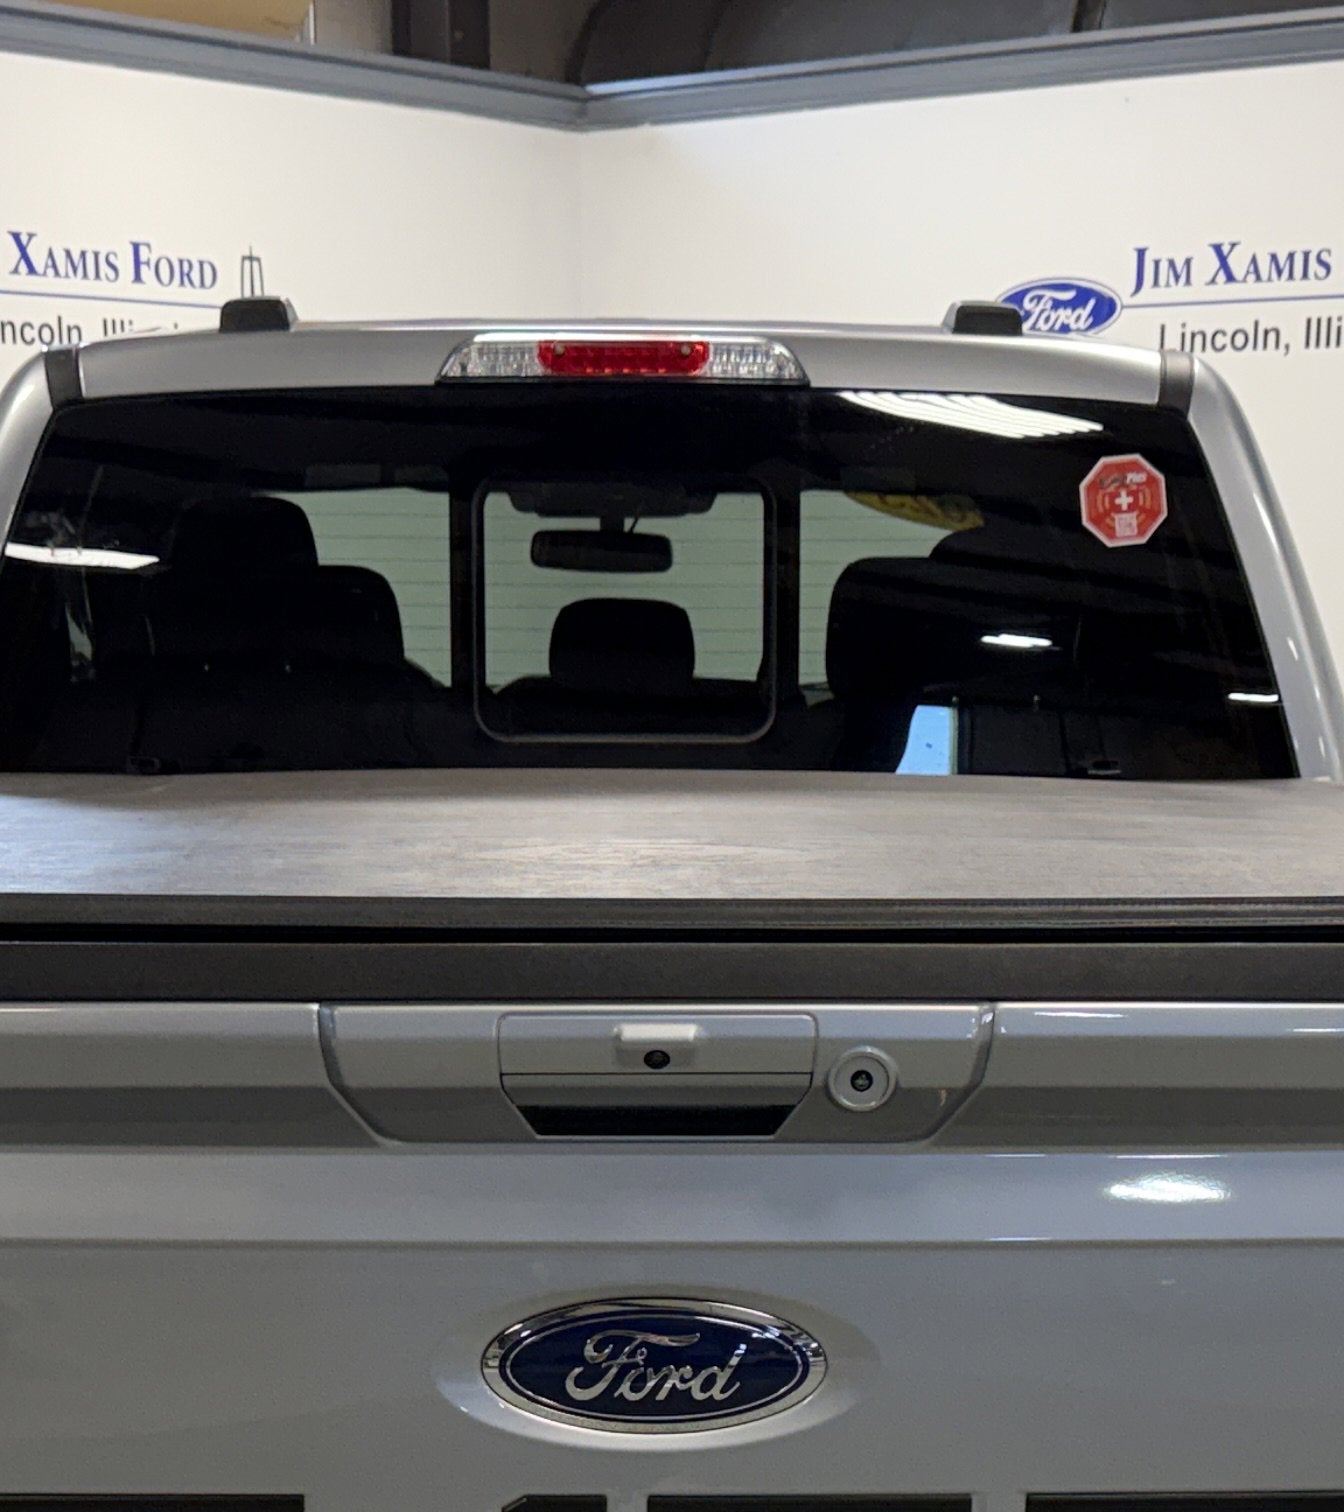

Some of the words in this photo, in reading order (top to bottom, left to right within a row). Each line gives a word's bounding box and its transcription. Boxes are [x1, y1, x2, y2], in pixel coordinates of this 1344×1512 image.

[7, 230, 120, 283] XAMIS
[129, 240, 218, 291] FORD
[1130, 246, 1193, 298] JIM
[1205, 241, 1333, 286] XAMIS
[1022, 287, 1097, 332] Ford
[1159, 319, 1291, 356] Lincoln,
[564, 1329, 748, 1401] Ford
